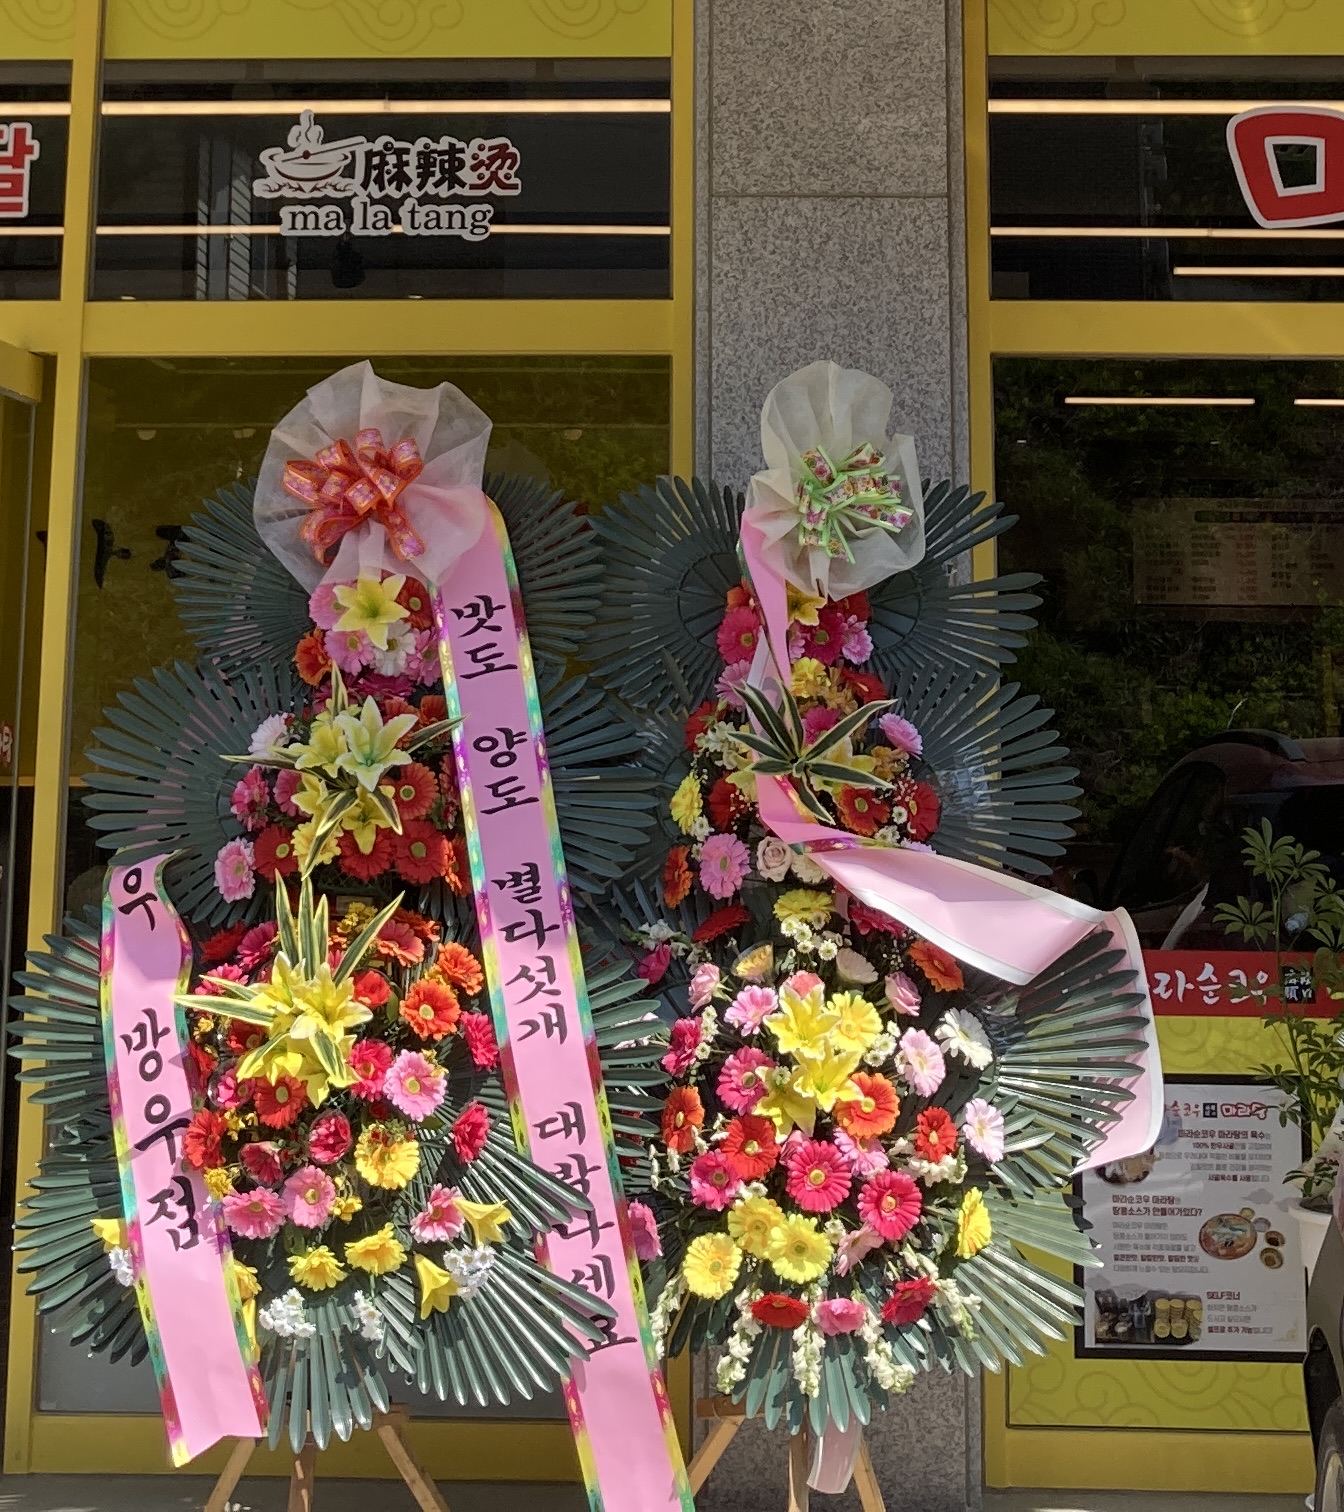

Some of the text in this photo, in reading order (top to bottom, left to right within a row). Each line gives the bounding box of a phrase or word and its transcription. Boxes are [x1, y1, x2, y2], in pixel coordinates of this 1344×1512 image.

[287, 201, 492, 236] ma la tang
[450, 594, 519, 680] 맛도
[472, 727, 539, 815] 양도
[491, 862, 568, 1045] 별다섯개
